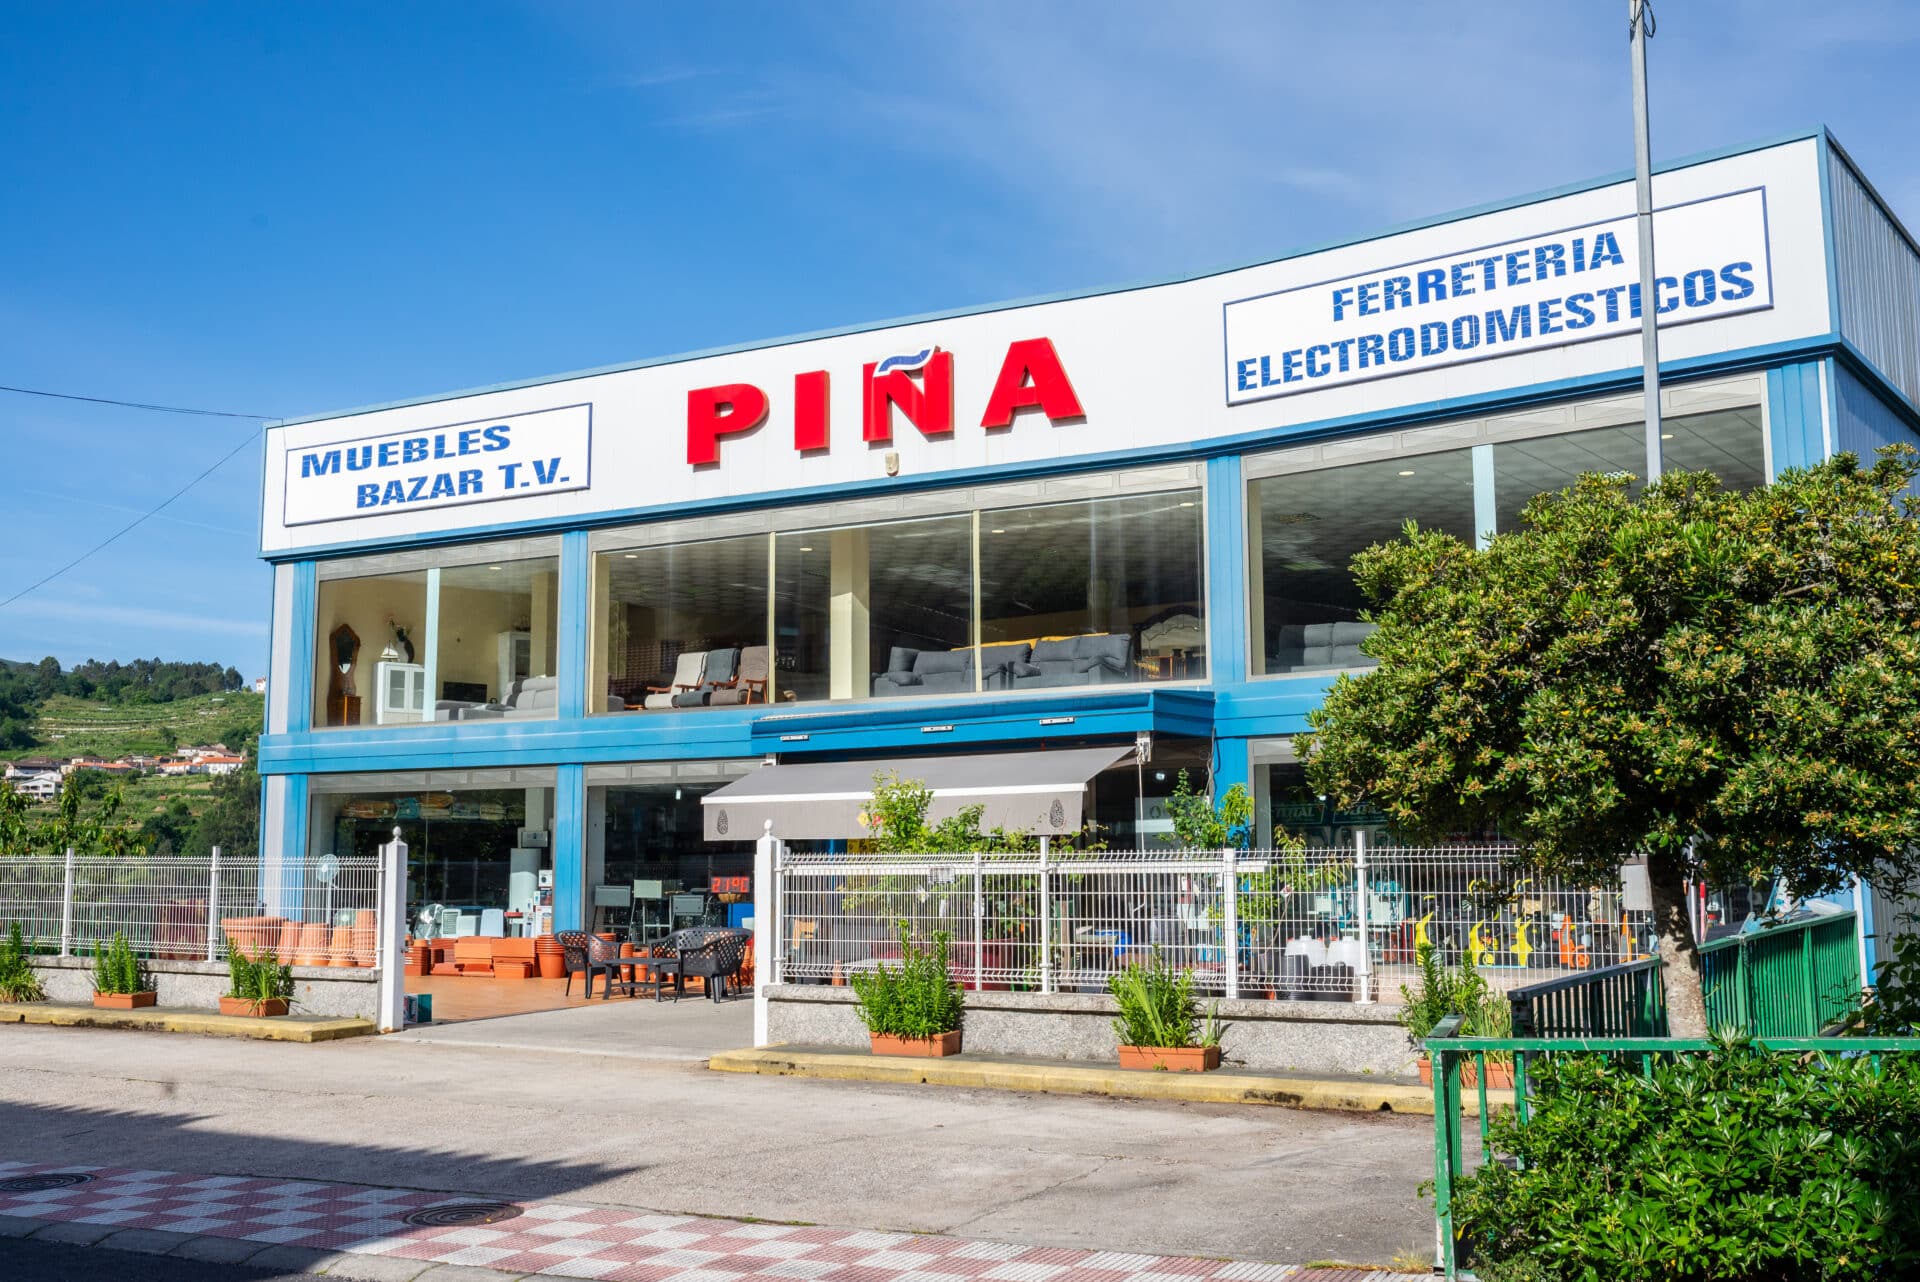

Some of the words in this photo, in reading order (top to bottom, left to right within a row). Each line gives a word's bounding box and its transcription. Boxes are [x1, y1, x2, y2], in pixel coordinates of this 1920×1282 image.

[1333, 231, 1625, 322] FERRETERIA
[1237, 261, 1755, 392] ELECTRODOMESTICOS
[687, 336, 1085, 465] PIÑA
[301, 425, 511, 478] MUEBLES
[356, 469, 483, 509] BAZAR
[498, 457, 570, 489] T.V.
